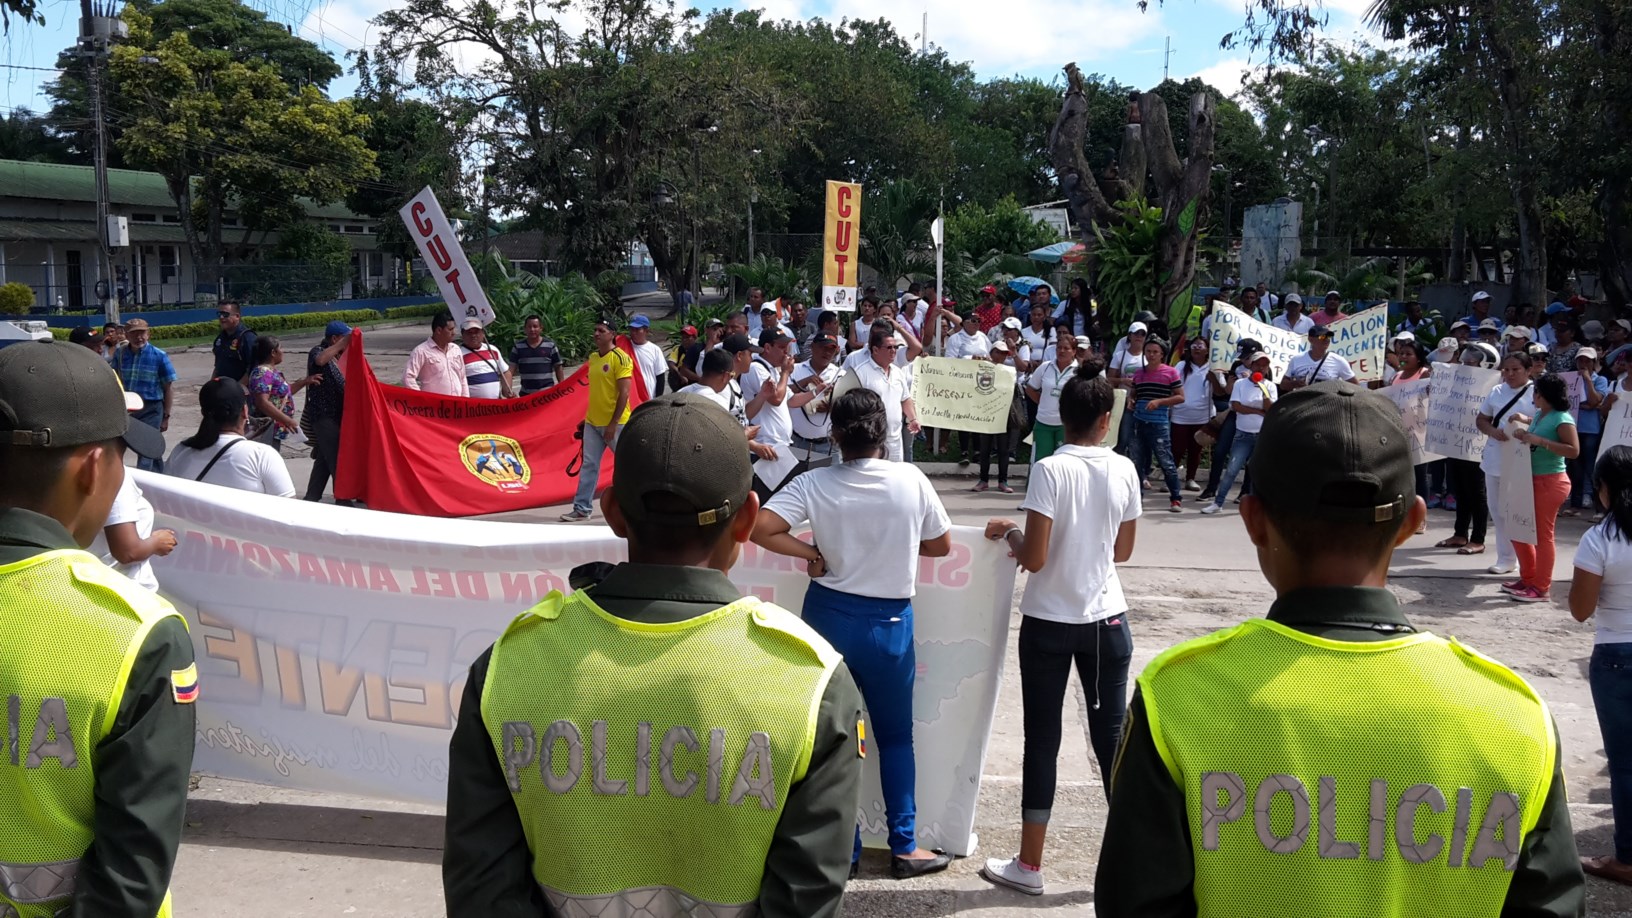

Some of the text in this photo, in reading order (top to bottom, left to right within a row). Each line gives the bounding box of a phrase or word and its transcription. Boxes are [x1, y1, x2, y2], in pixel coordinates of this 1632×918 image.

[410, 201, 467, 305] CUT
[834, 186, 852, 285] CUT
[1214, 309, 1241, 329] POR
[1247, 321, 1263, 339] LA
[394, 399, 435, 418] Obrera
[437, 400, 451, 418] de
[453, 401, 463, 419] la
[502, 719, 778, 810] POLICIA
[1200, 770, 1522, 872] POLICIA
